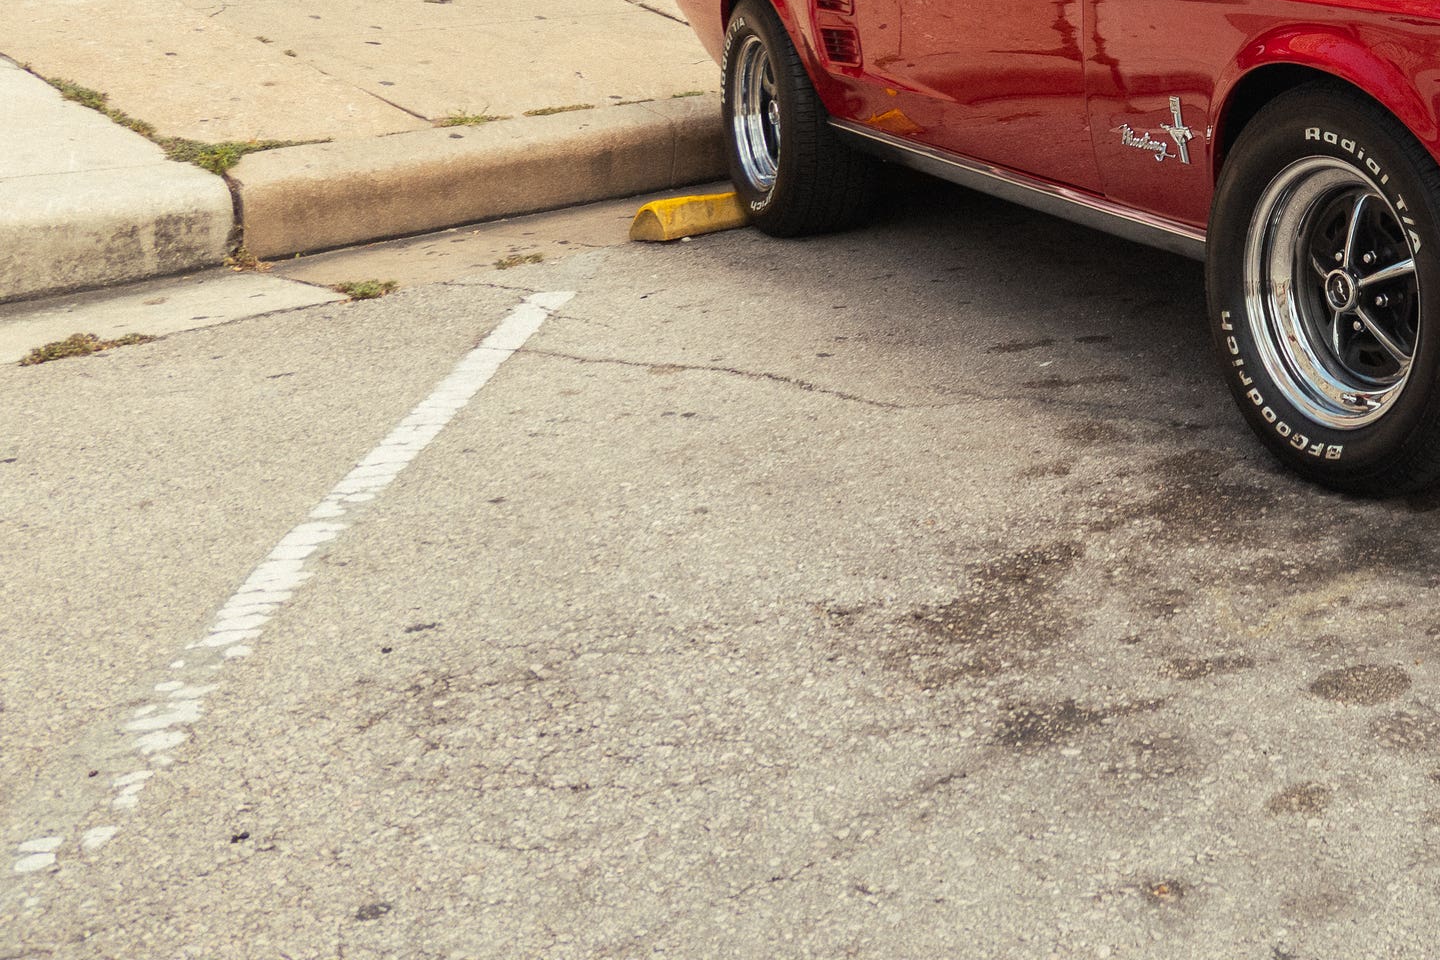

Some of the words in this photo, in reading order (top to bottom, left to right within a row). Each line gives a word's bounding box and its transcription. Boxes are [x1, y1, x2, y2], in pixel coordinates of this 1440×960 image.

[1118, 123, 1177, 162] Mustang
[1304, 127, 1390, 185] Radial
[1395, 193, 1422, 255] T/A
[1220, 310, 1344, 460] BFGoodrich
